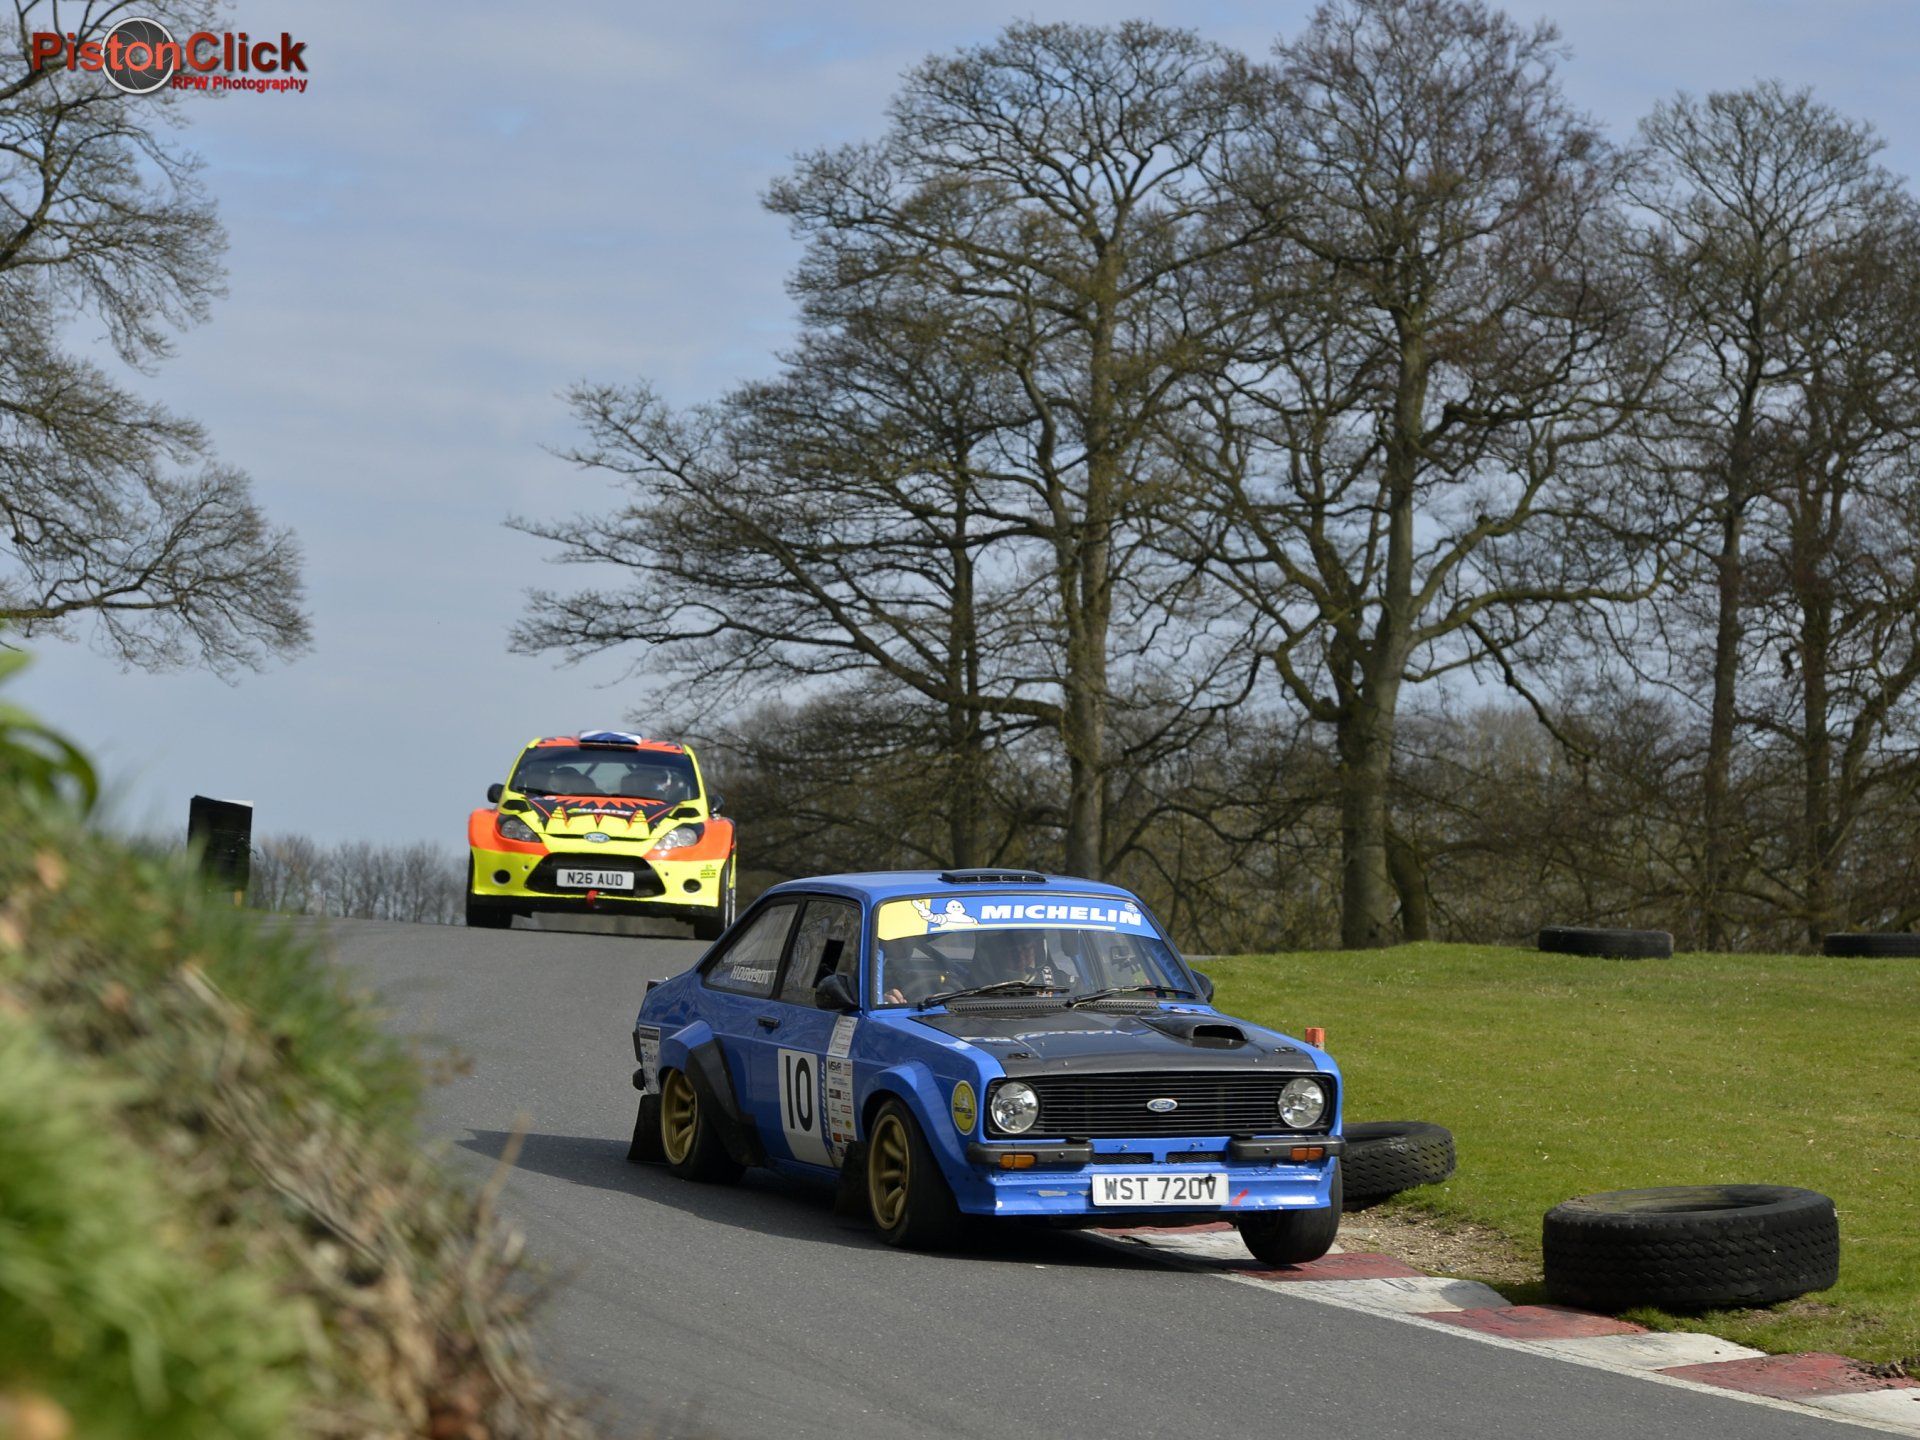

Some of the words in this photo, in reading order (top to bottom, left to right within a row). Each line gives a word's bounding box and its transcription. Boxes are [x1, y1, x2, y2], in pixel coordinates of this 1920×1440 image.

[567, 871, 593, 884] N26
[597, 872, 623, 886] AUD
[981, 904, 1142, 926] MICHELIN
[785, 1055, 814, 1132] 10
[1104, 1177, 1149, 1200] WST
[1157, 1177, 1217, 1200] 720V
